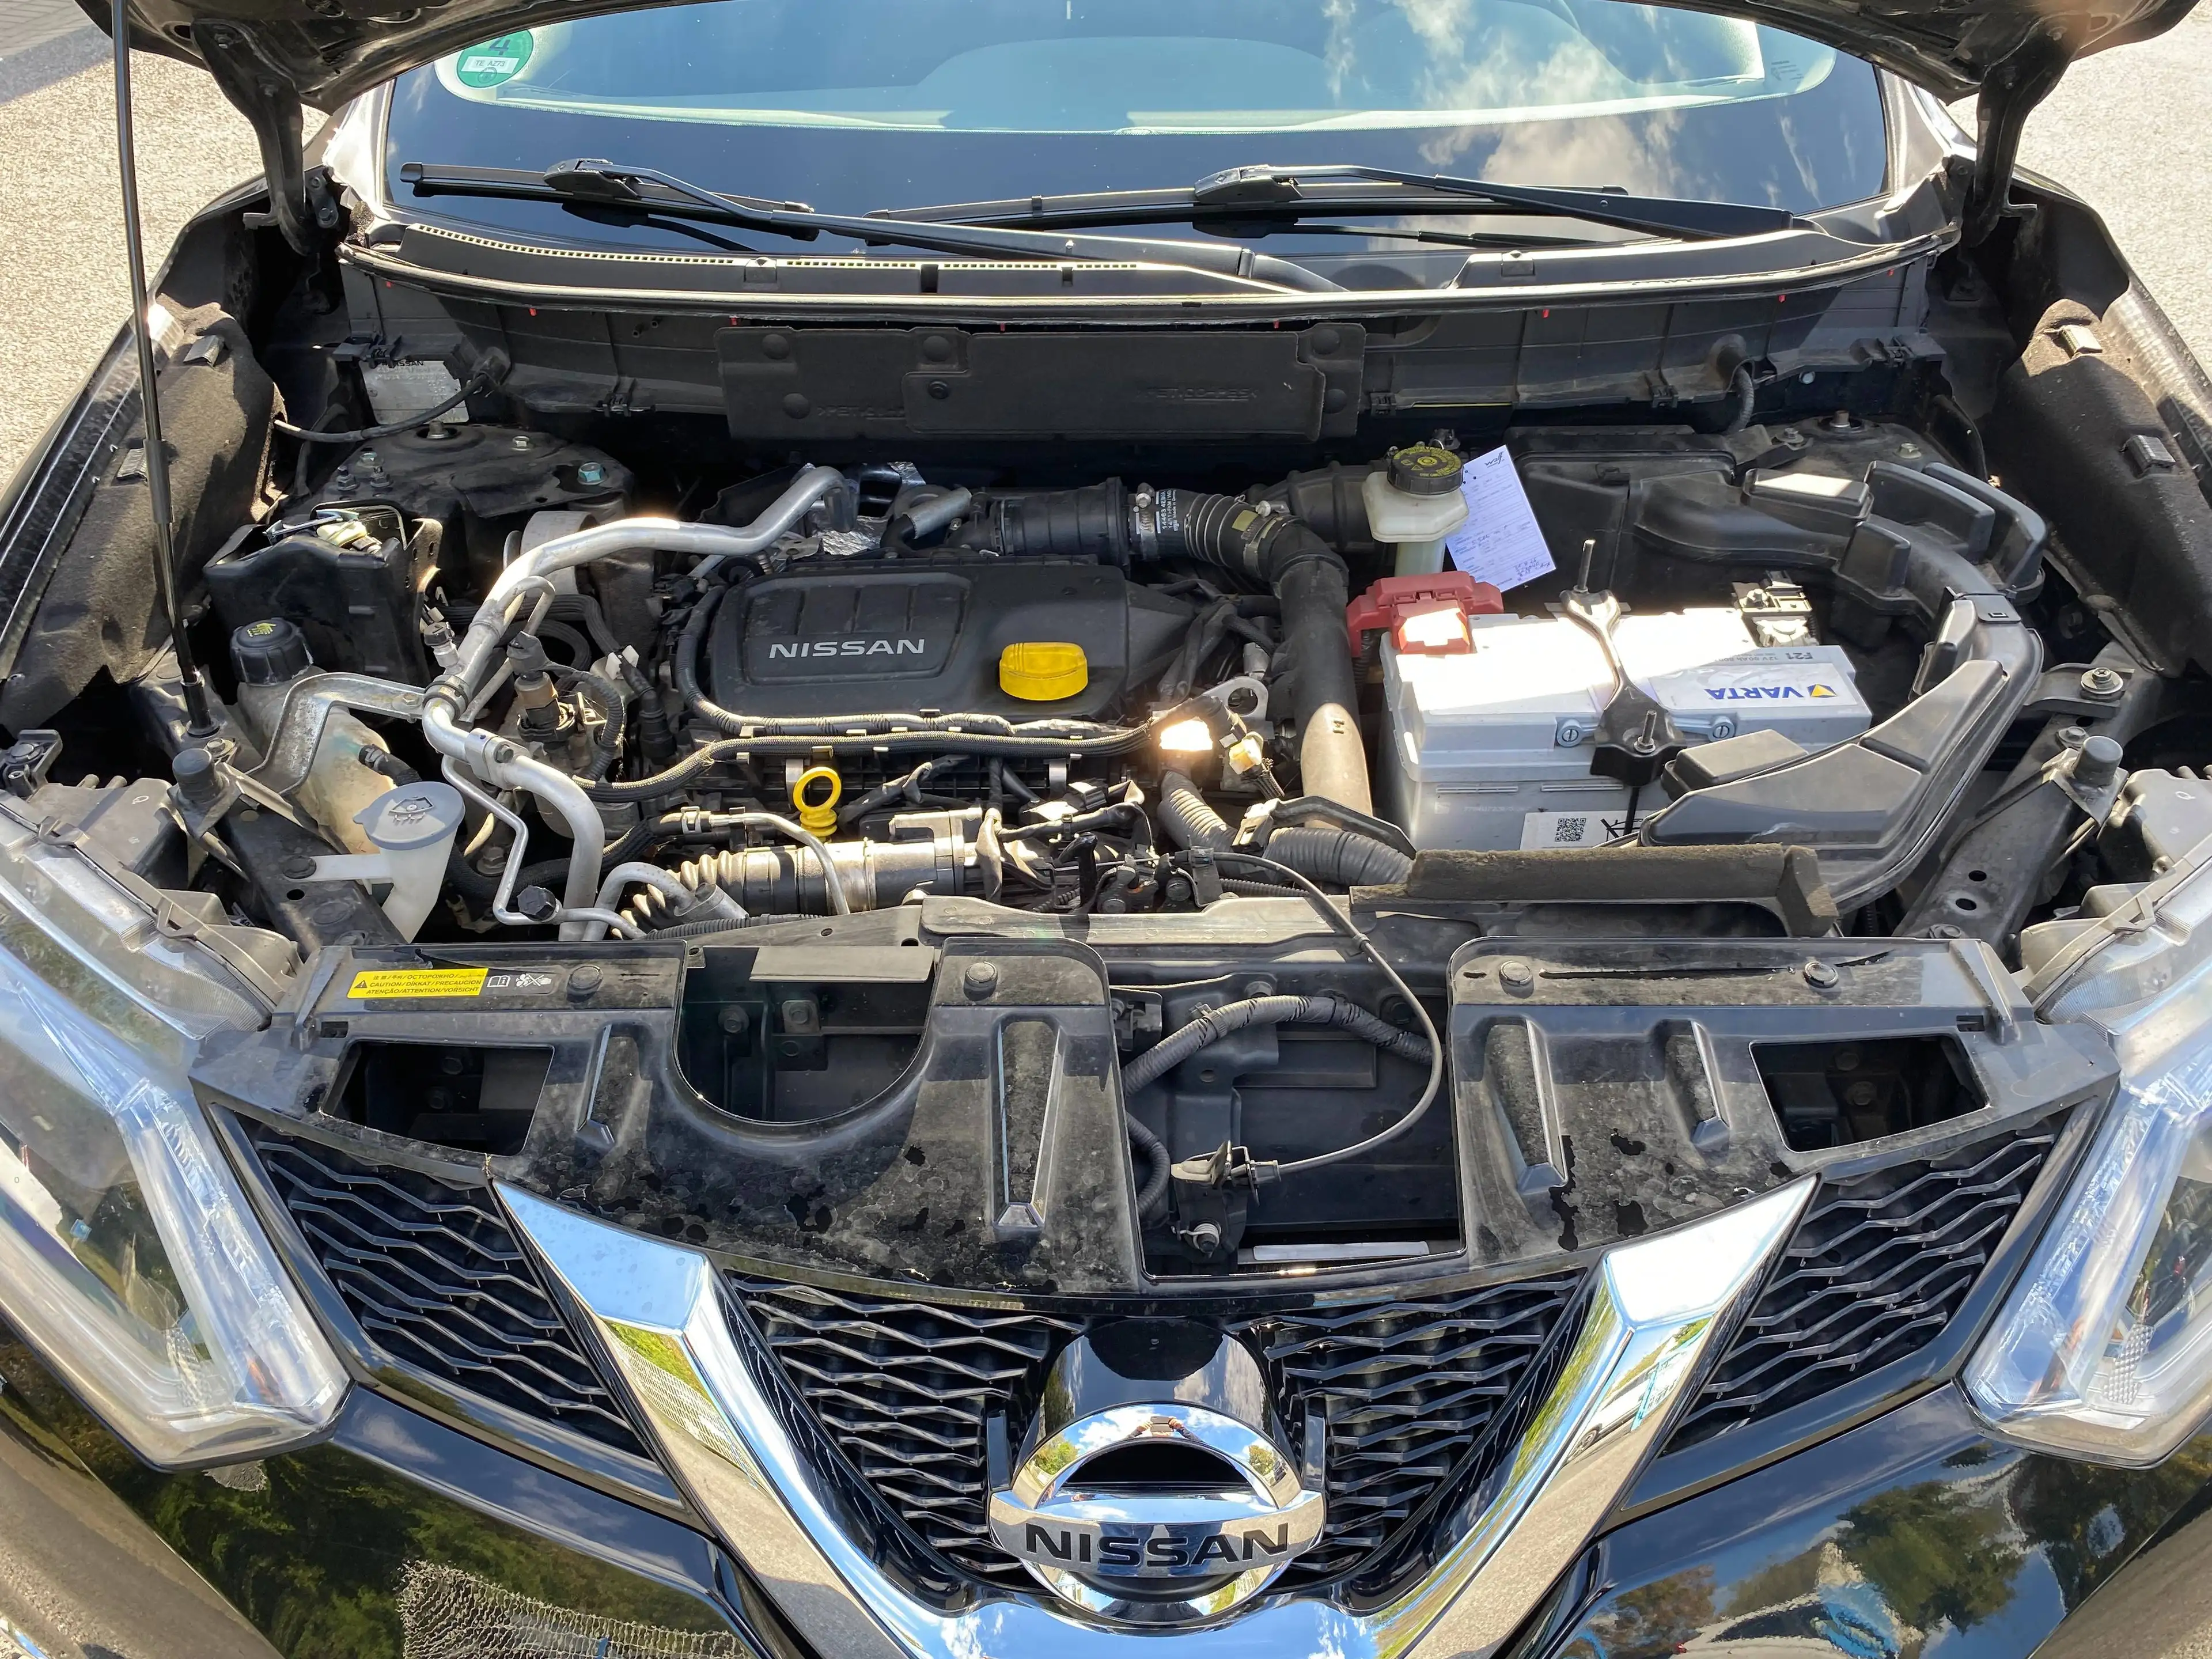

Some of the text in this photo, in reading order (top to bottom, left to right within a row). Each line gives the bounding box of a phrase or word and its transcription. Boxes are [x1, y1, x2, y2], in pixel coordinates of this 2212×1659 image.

[768, 638, 925, 659] NISSAN
[1703, 686, 1804, 700] VARTA
[1025, 1522, 1288, 1567] NISSAN
